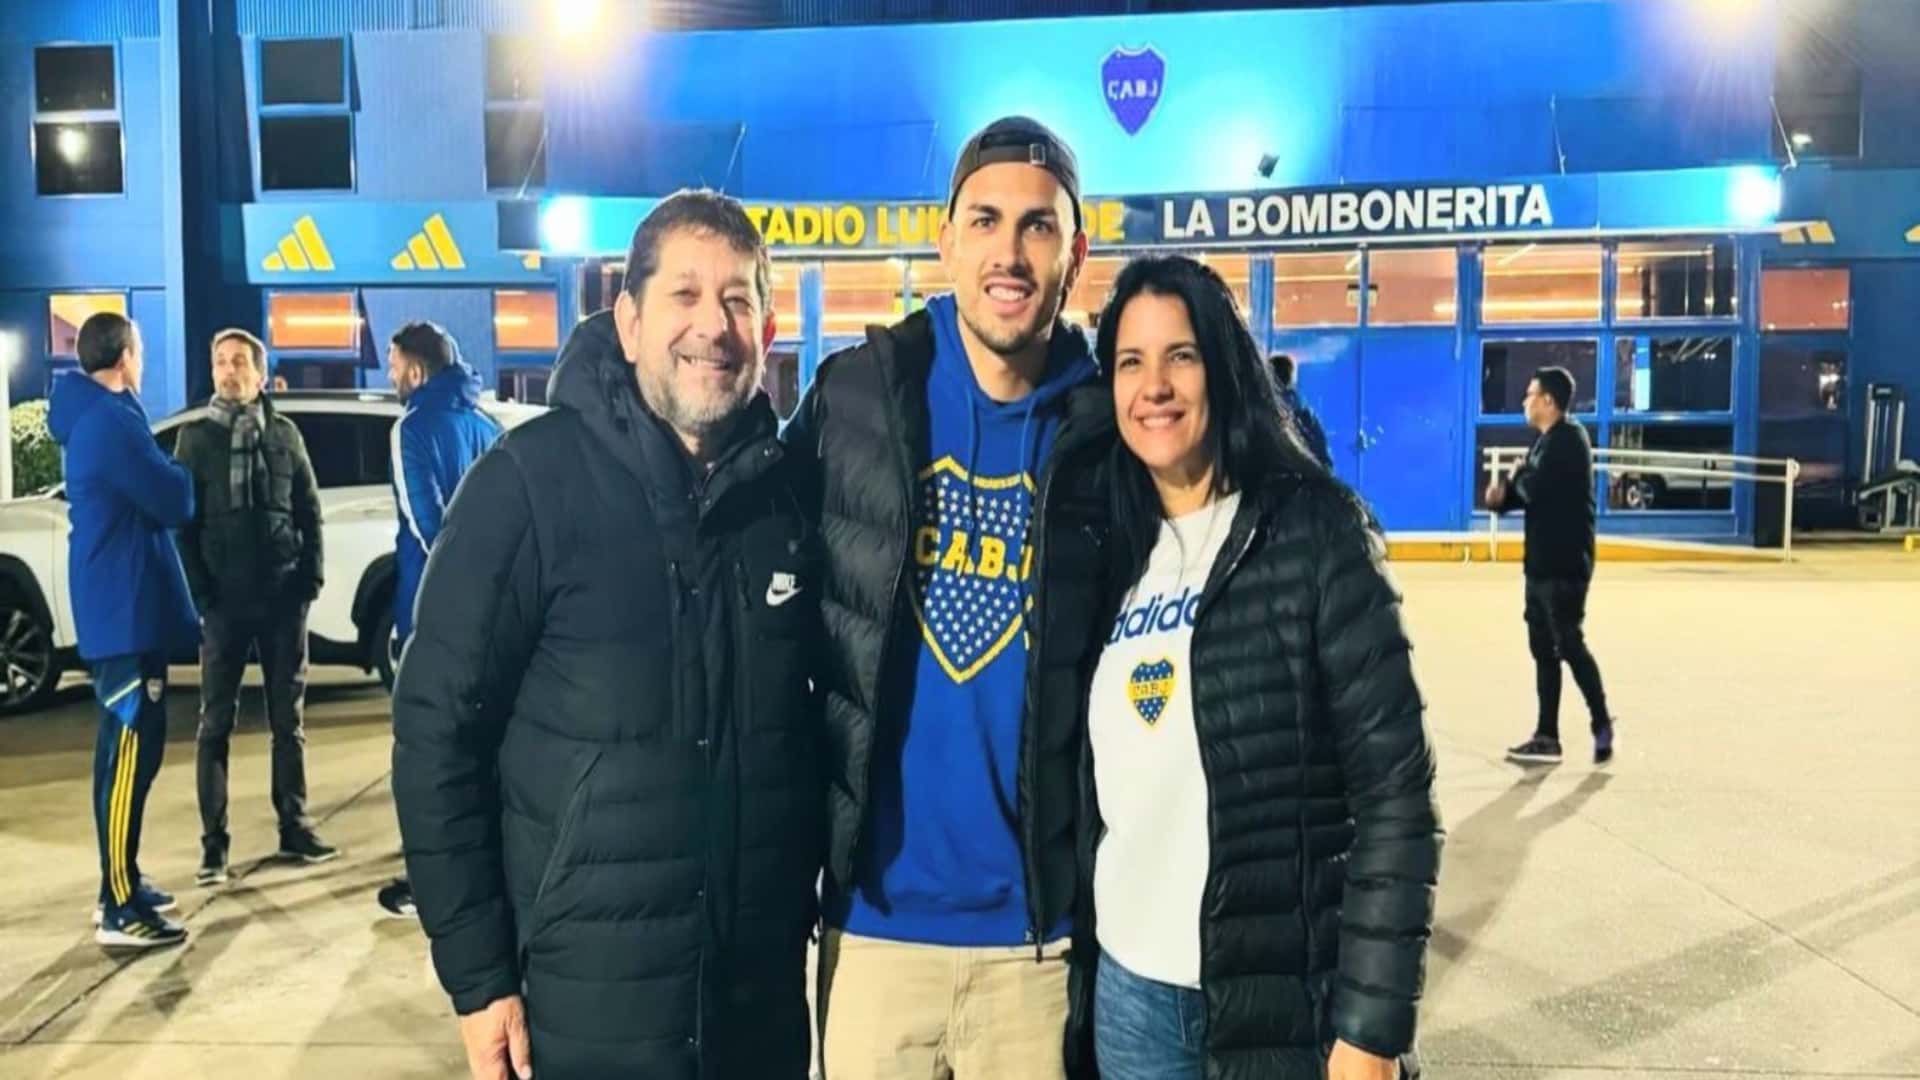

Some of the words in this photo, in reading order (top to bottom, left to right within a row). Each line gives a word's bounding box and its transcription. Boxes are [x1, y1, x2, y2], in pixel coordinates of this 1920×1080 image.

[1107, 79, 1159, 100] CABJ
[743, 205, 866, 246] TADIO
[1163, 199, 1215, 239] LA
[1228, 183, 1554, 237] BOMBONERITA
